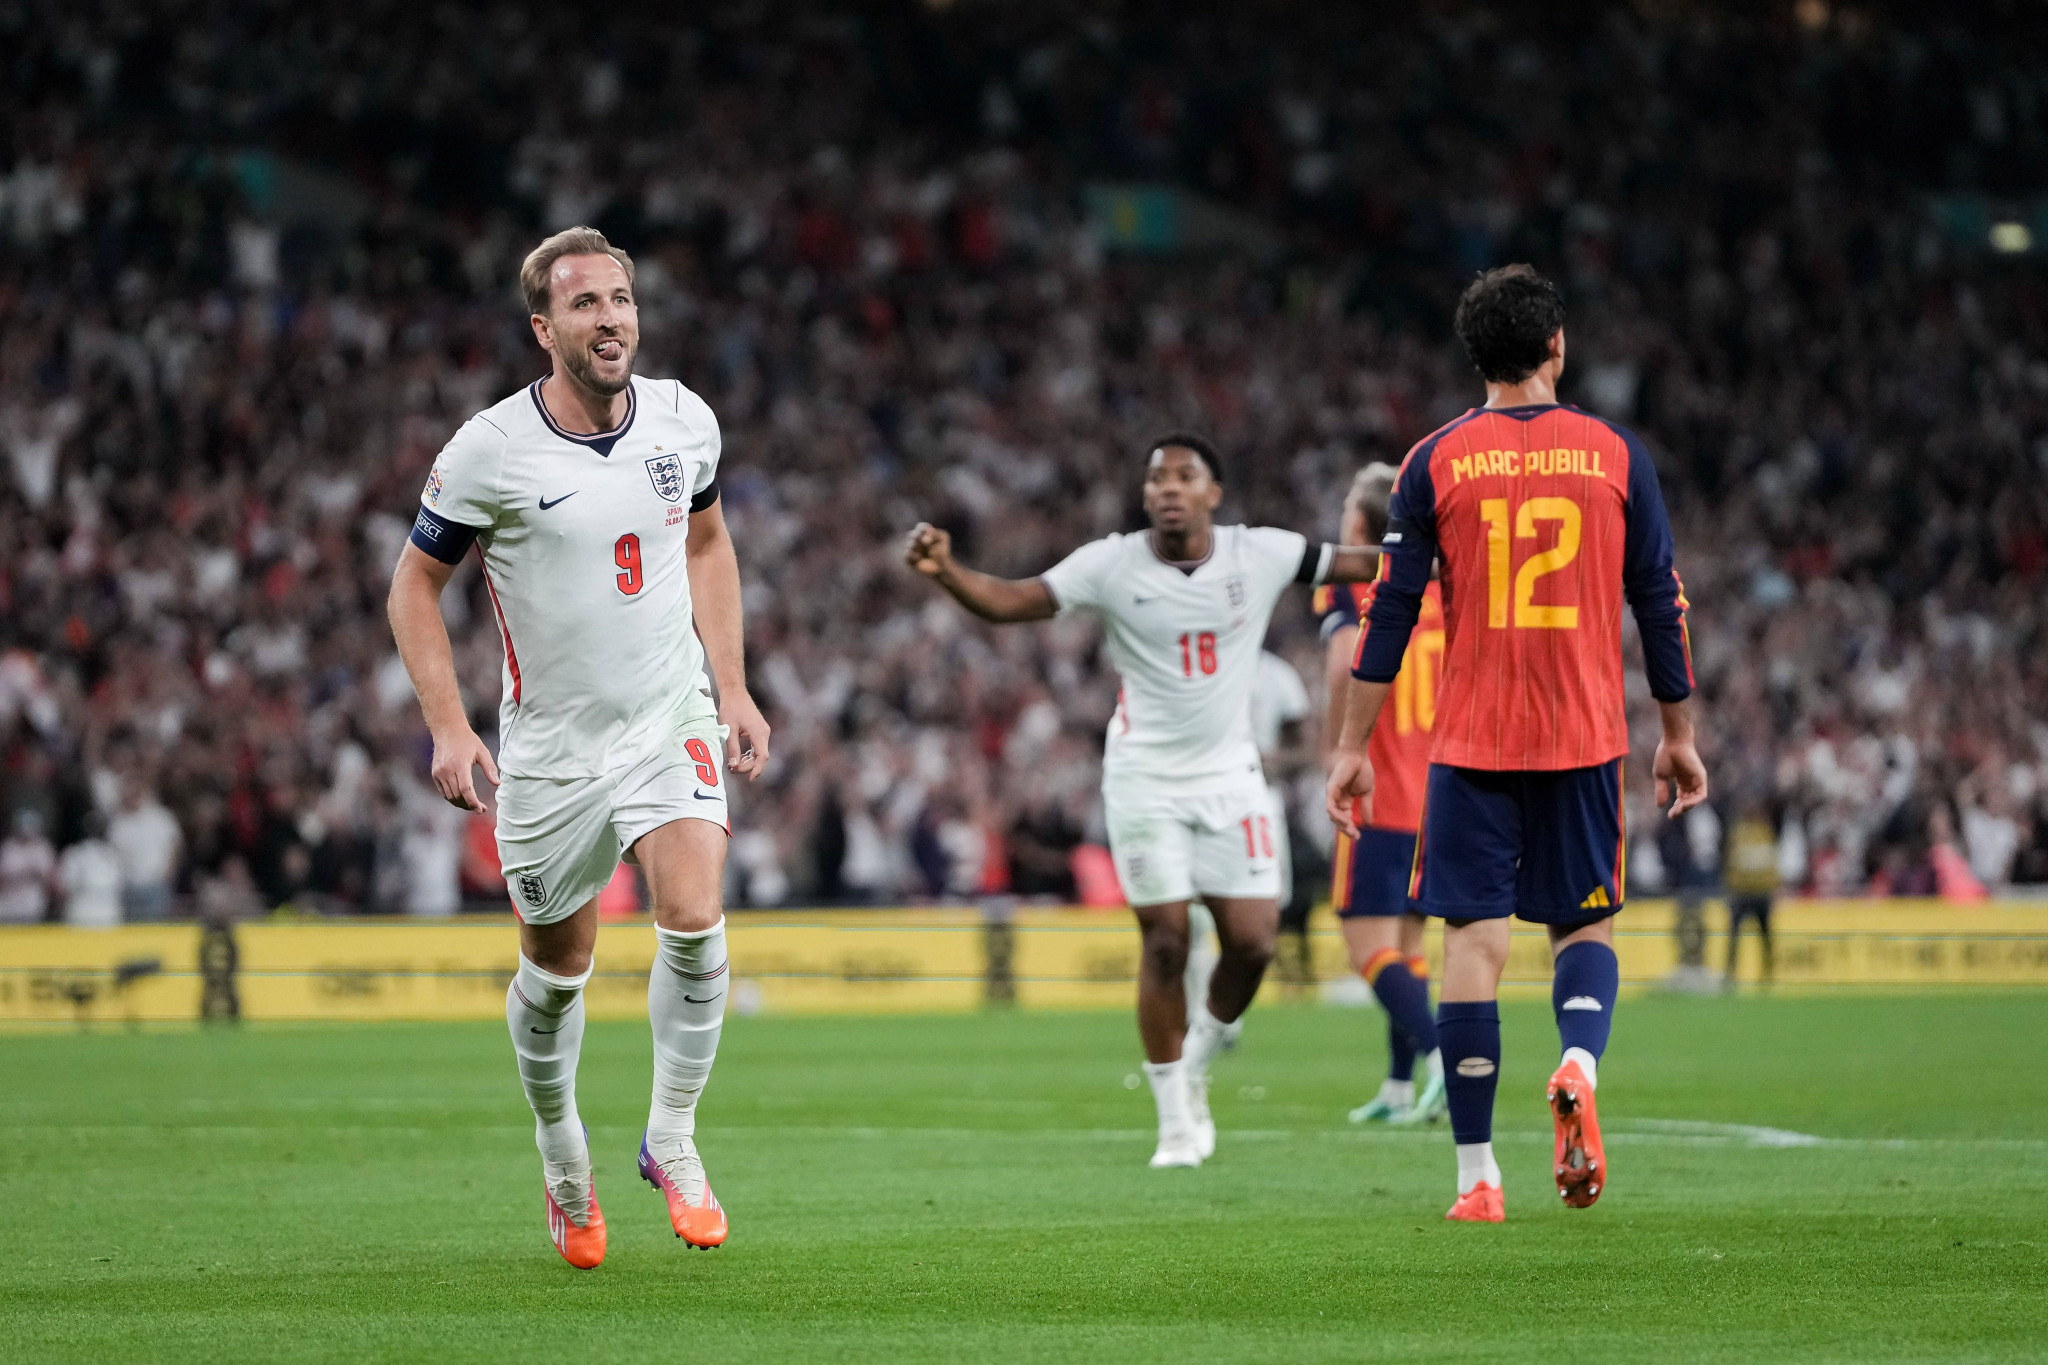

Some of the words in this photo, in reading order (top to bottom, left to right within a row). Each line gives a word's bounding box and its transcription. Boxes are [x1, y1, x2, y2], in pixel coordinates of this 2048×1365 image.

[1451, 450, 1520, 483] MARC
[1524, 449, 1606, 478] PUBILL
[416, 511, 442, 538] ESPECT
[667, 507, 682, 516] SPAIN
[615, 533, 643, 595] 9
[1480, 497, 1582, 628] 12
[1179, 631, 1217, 677] 18
[684, 738, 719, 787] 9
